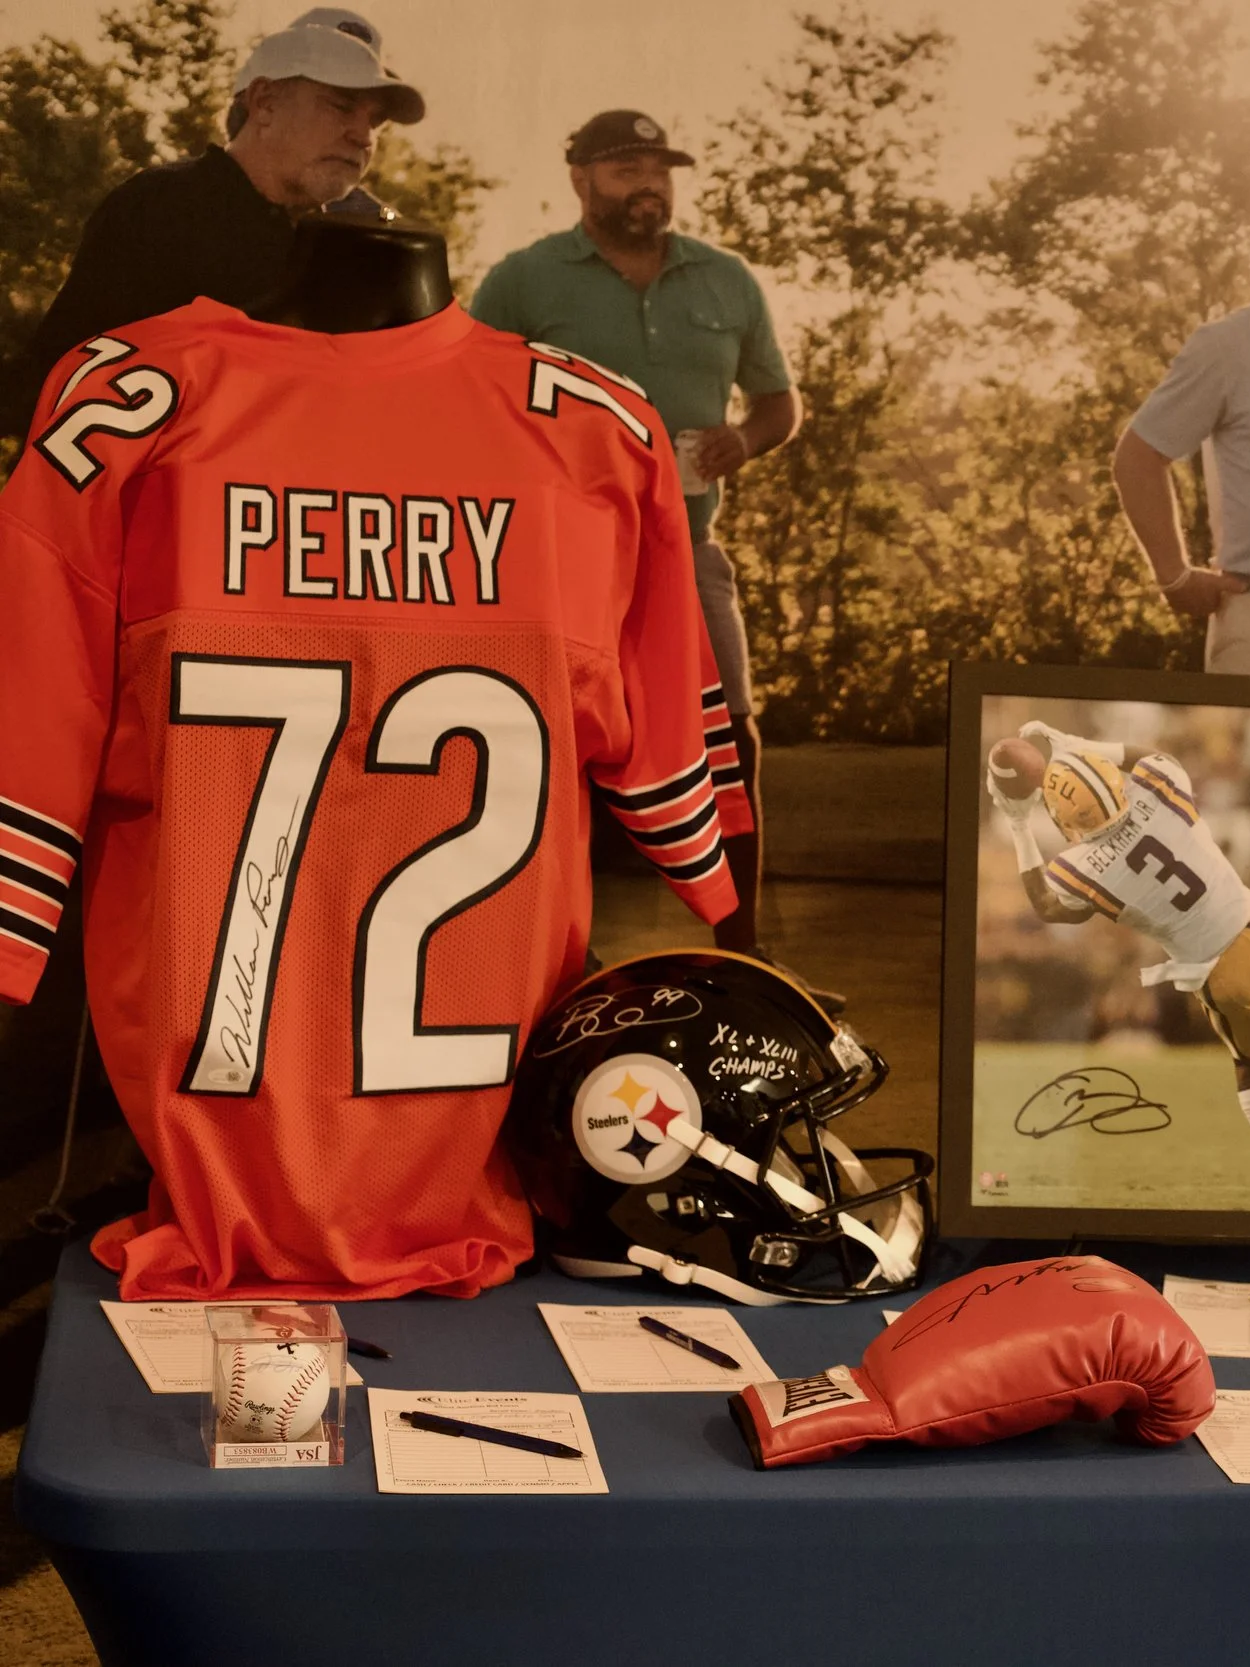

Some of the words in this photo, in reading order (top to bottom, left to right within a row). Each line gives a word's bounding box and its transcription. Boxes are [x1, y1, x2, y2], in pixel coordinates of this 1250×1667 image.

[33, 334, 181, 494] 72
[223, 482, 516, 606] PERRY
[1086, 812, 1143, 875] BECKHAM
[1134, 798, 1156, 823] JR
[168, 652, 550, 1097] 72
[1125, 833, 1208, 913] 3
[708, 1056, 786, 1081] CHAMPS
[709, 1022, 739, 1047] XL
[758, 1036, 799, 1064] XLIII
[586, 1113, 630, 1132] Steelers
[244, 1400, 276, 1415] Rawlings
[295, 1446, 323, 1462] JSA
